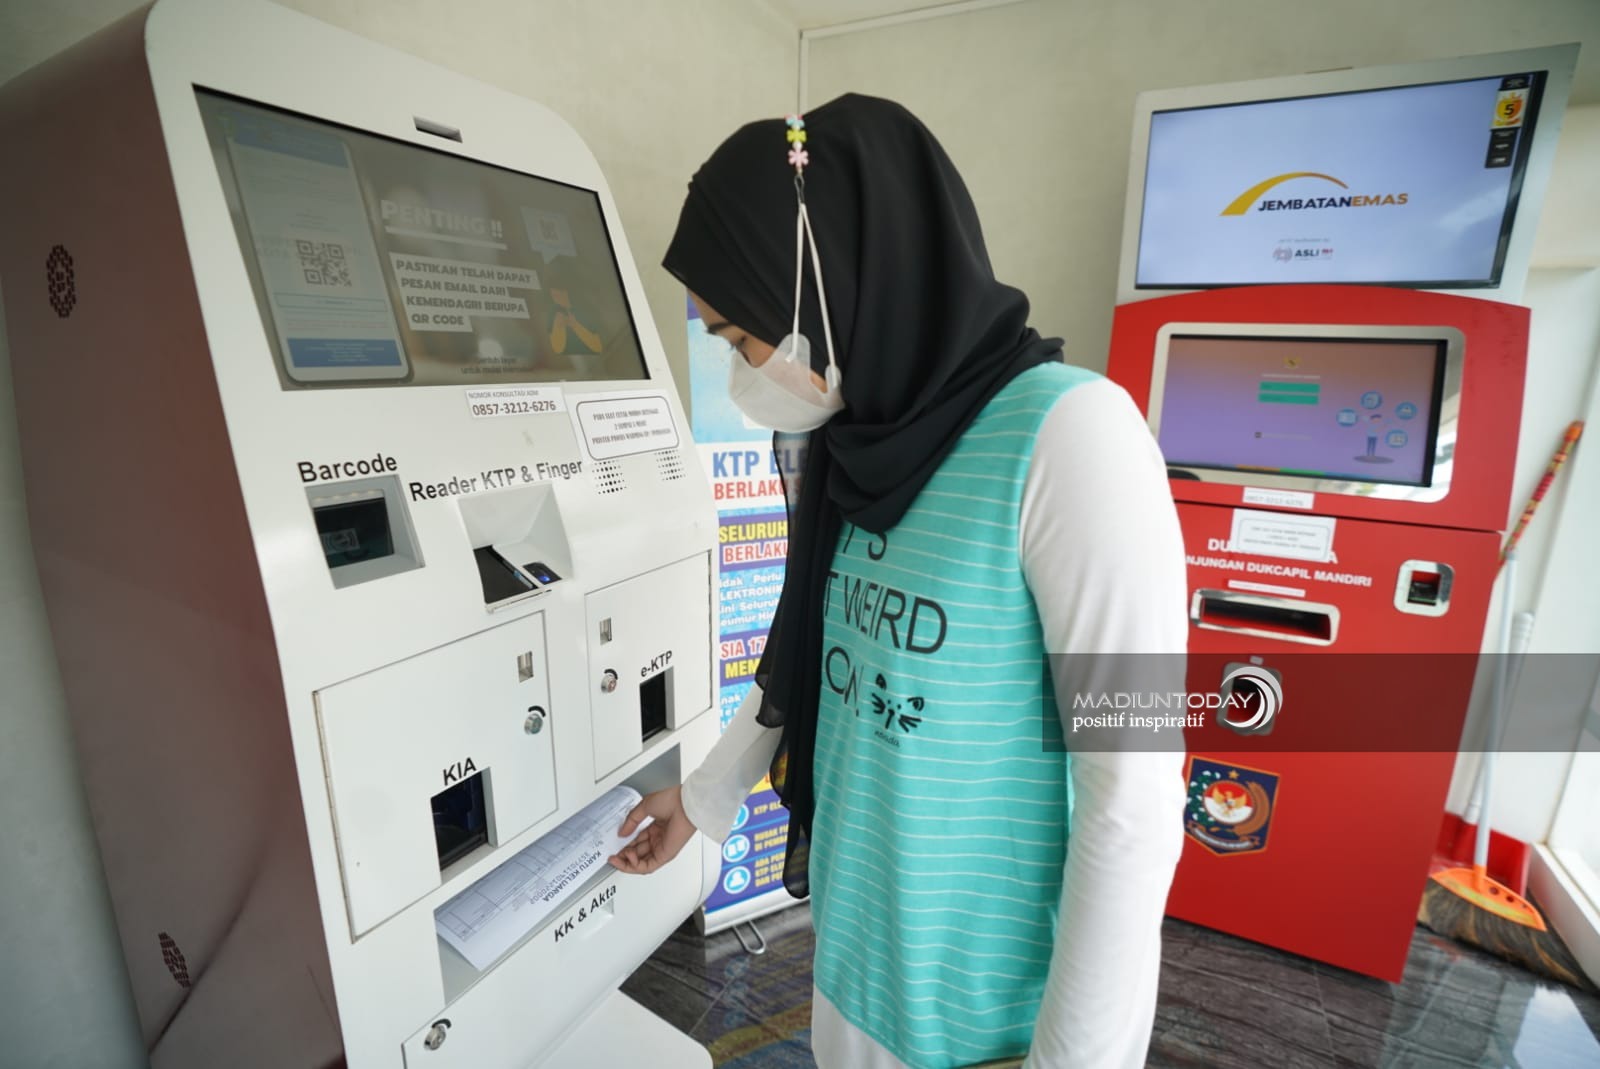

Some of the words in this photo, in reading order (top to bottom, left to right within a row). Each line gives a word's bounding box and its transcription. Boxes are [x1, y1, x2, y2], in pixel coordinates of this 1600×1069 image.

[1502, 103, 1516, 116] 5
[1258, 193, 1408, 211] JEMBATANEMAS
[381, 200, 485, 234] PENTING
[1294, 248, 1320, 257] ASLI
[396, 260, 458, 275] PASTIKAN
[460, 267, 494, 280] TELAH
[497, 272, 531, 283] DAPAT
[401, 278, 441, 290] PESAN
[444, 282, 478, 294] EMAIL
[480, 286, 506, 296] DARI
[406, 296, 481, 310] KEMENDAGRI
[485, 302, 525, 313] BERUPA
[411, 313, 430, 324] QR
[433, 315, 464, 325] CODE
[472, 400, 556, 416] 0857-3212-6276
[298, 453, 398, 482] Barcode
[713, 450, 760, 478] KTP
[409, 476, 477, 501] Reader
[481, 467, 516, 490] KTP
[521, 465, 534, 483] &
[537, 460, 583, 481] Finger
[719, 520, 788, 543] SELURUH
[1246, 561, 1311, 580] DUKCAPIL
[1314, 570, 1372, 587] MANDIRI
[844, 575, 947, 654] WEIRD
[641, 650, 673, 677] e-KTP
[443, 757, 477, 786] KIA
[578, 850, 602, 872] KARTU
[542, 870, 580, 902] KELUARGA
[555, 916, 575, 943] KK
[578, 907, 587, 923] &
[590, 885, 616, 914] Akta
